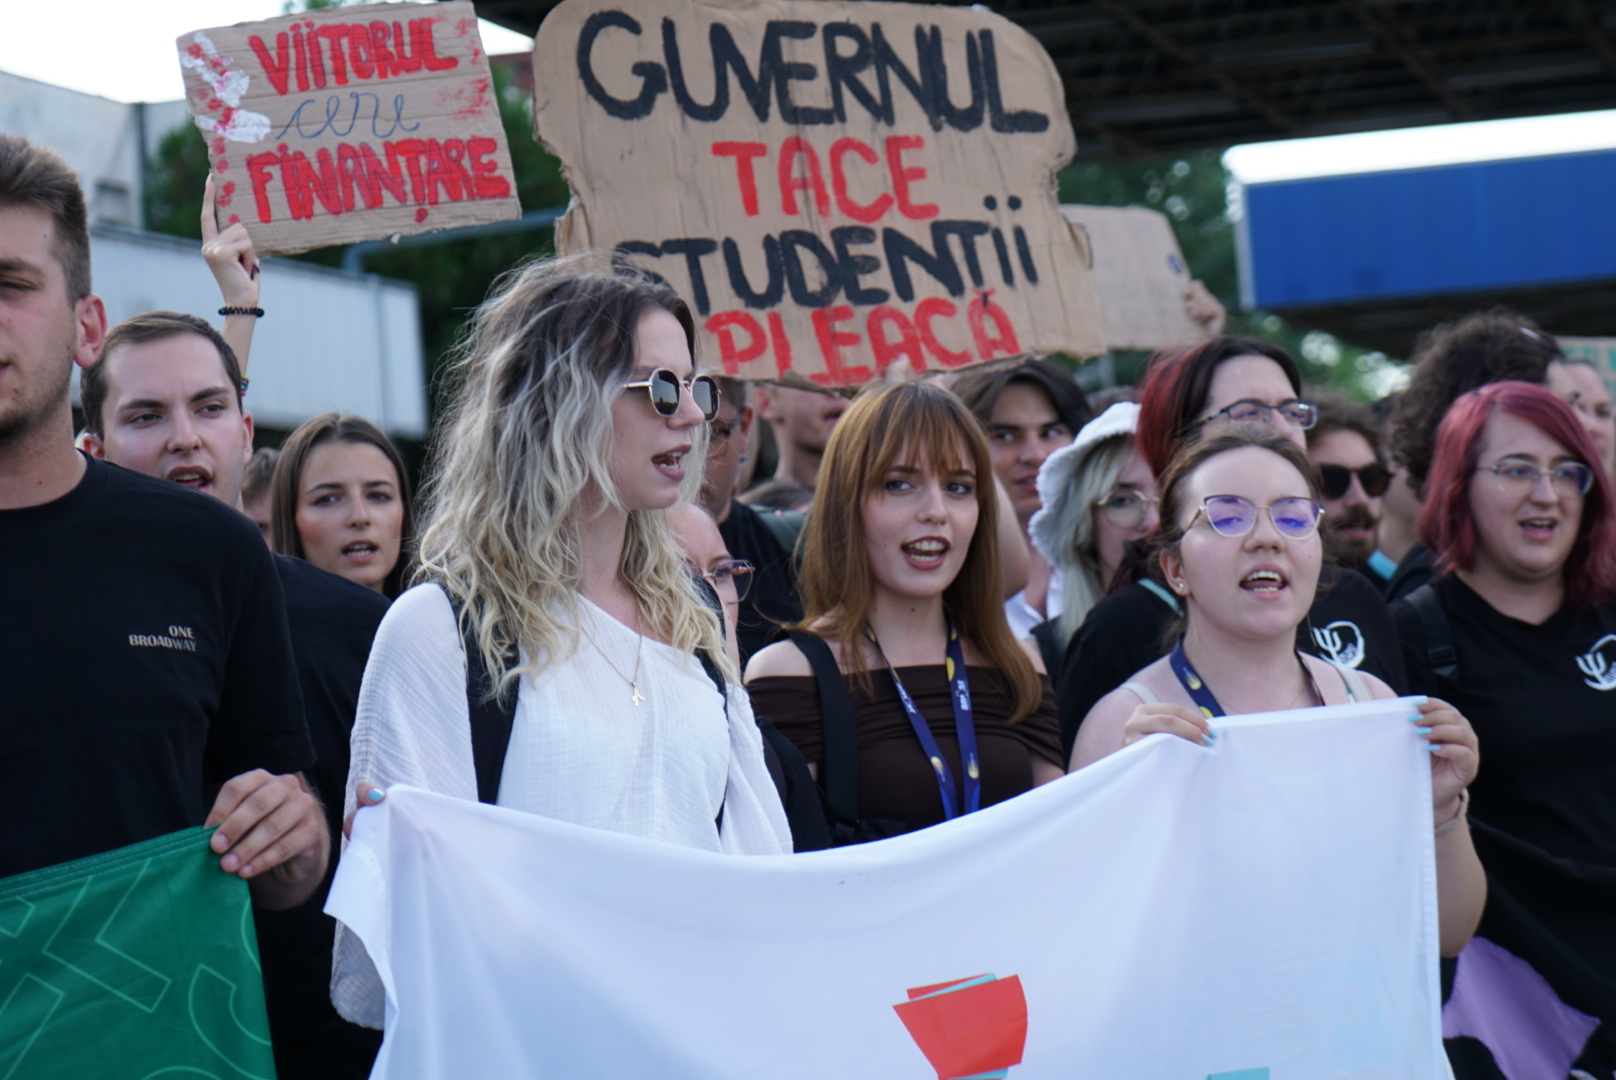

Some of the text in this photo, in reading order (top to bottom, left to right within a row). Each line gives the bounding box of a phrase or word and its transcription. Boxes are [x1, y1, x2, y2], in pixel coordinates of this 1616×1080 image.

[575, 10, 1050, 133] GUVERNUL
[711, 134, 940, 223] TACE
[128, 634, 197, 652] BROADWAY
[168, 625, 195, 639] ONE
